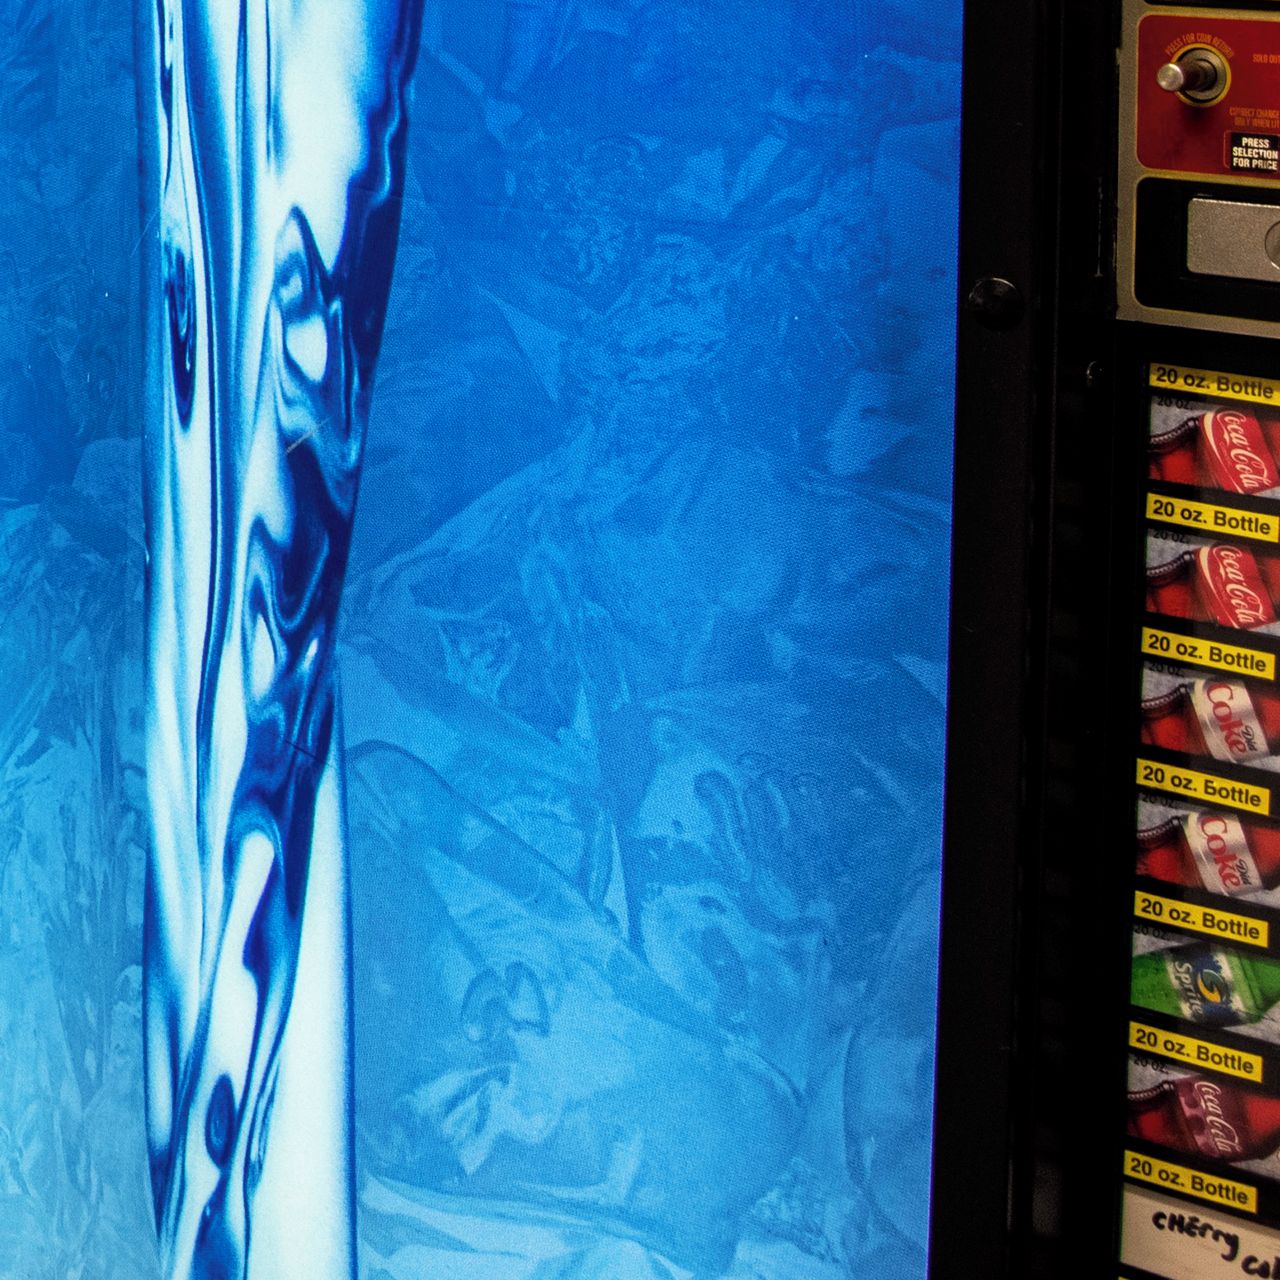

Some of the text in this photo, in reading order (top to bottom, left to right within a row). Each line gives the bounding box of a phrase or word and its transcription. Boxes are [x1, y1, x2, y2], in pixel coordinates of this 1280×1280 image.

[1232, 146, 1279, 160] SELECTION
[1233, 157, 1278, 170] FOR PRICE
[1242, 137, 1269, 148] PRESS
[1156, 366, 1274, 400] 20 oz. Bottle
[1153, 499, 1271, 536] 20 oz. Bottle
[1148, 633, 1266, 672] 20 oz. Bottle
[1206, 683, 1247, 756] Coke
[1143, 765, 1262, 808] 20 oz. Bottle
[1200, 815, 1242, 889] Coke
[1141, 898, 1260, 940] 20 oz. Bottle
[1175, 961, 1203, 1015] Sprite
[1135, 1028, 1254, 1075] 20 oz. Bottle
[1130, 1157, 1249, 1205] 20 oz. Bottle
